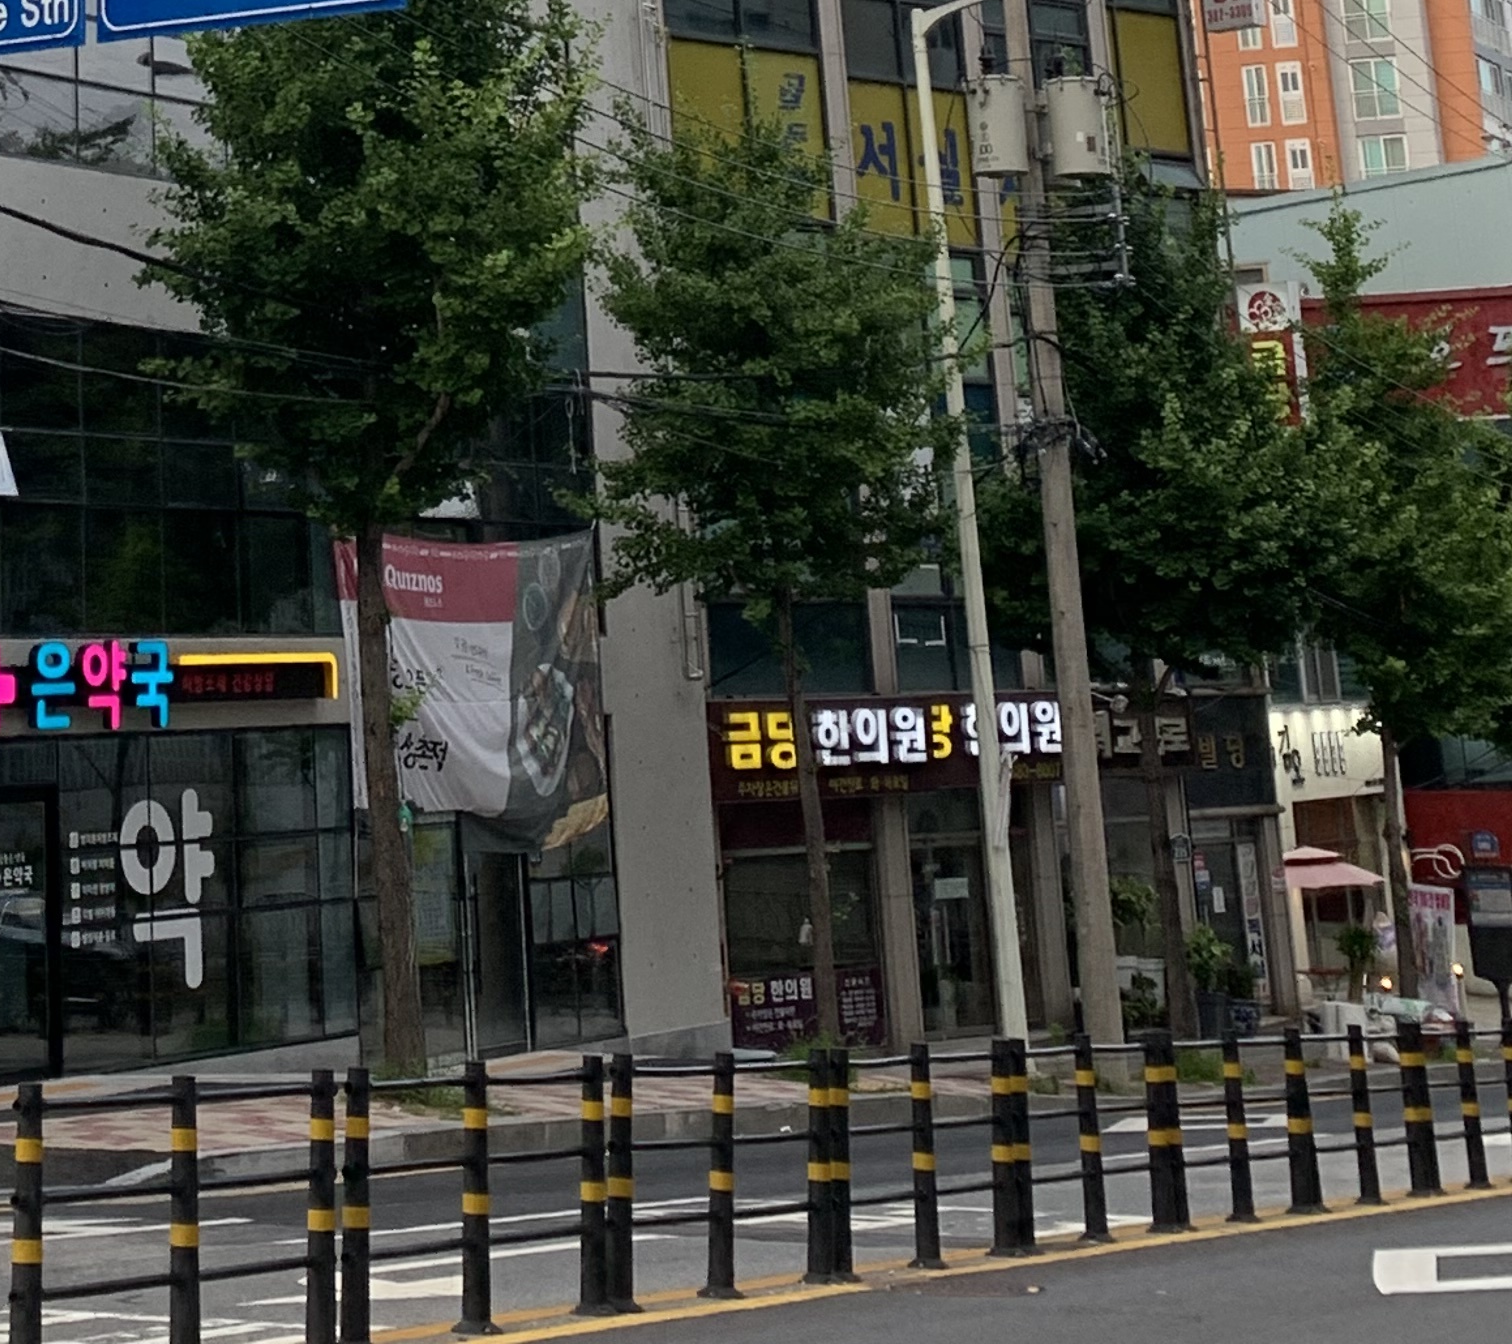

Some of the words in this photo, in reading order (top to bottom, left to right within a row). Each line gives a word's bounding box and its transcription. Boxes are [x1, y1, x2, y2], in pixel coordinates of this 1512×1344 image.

[31, 639, 174, 729] 은약국
[726, 711, 797, 770] 금당
[814, 705, 928, 767] 한의원
[3, 864, 34, 887] 은약국
[770, 976, 813, 1003] 한의원
